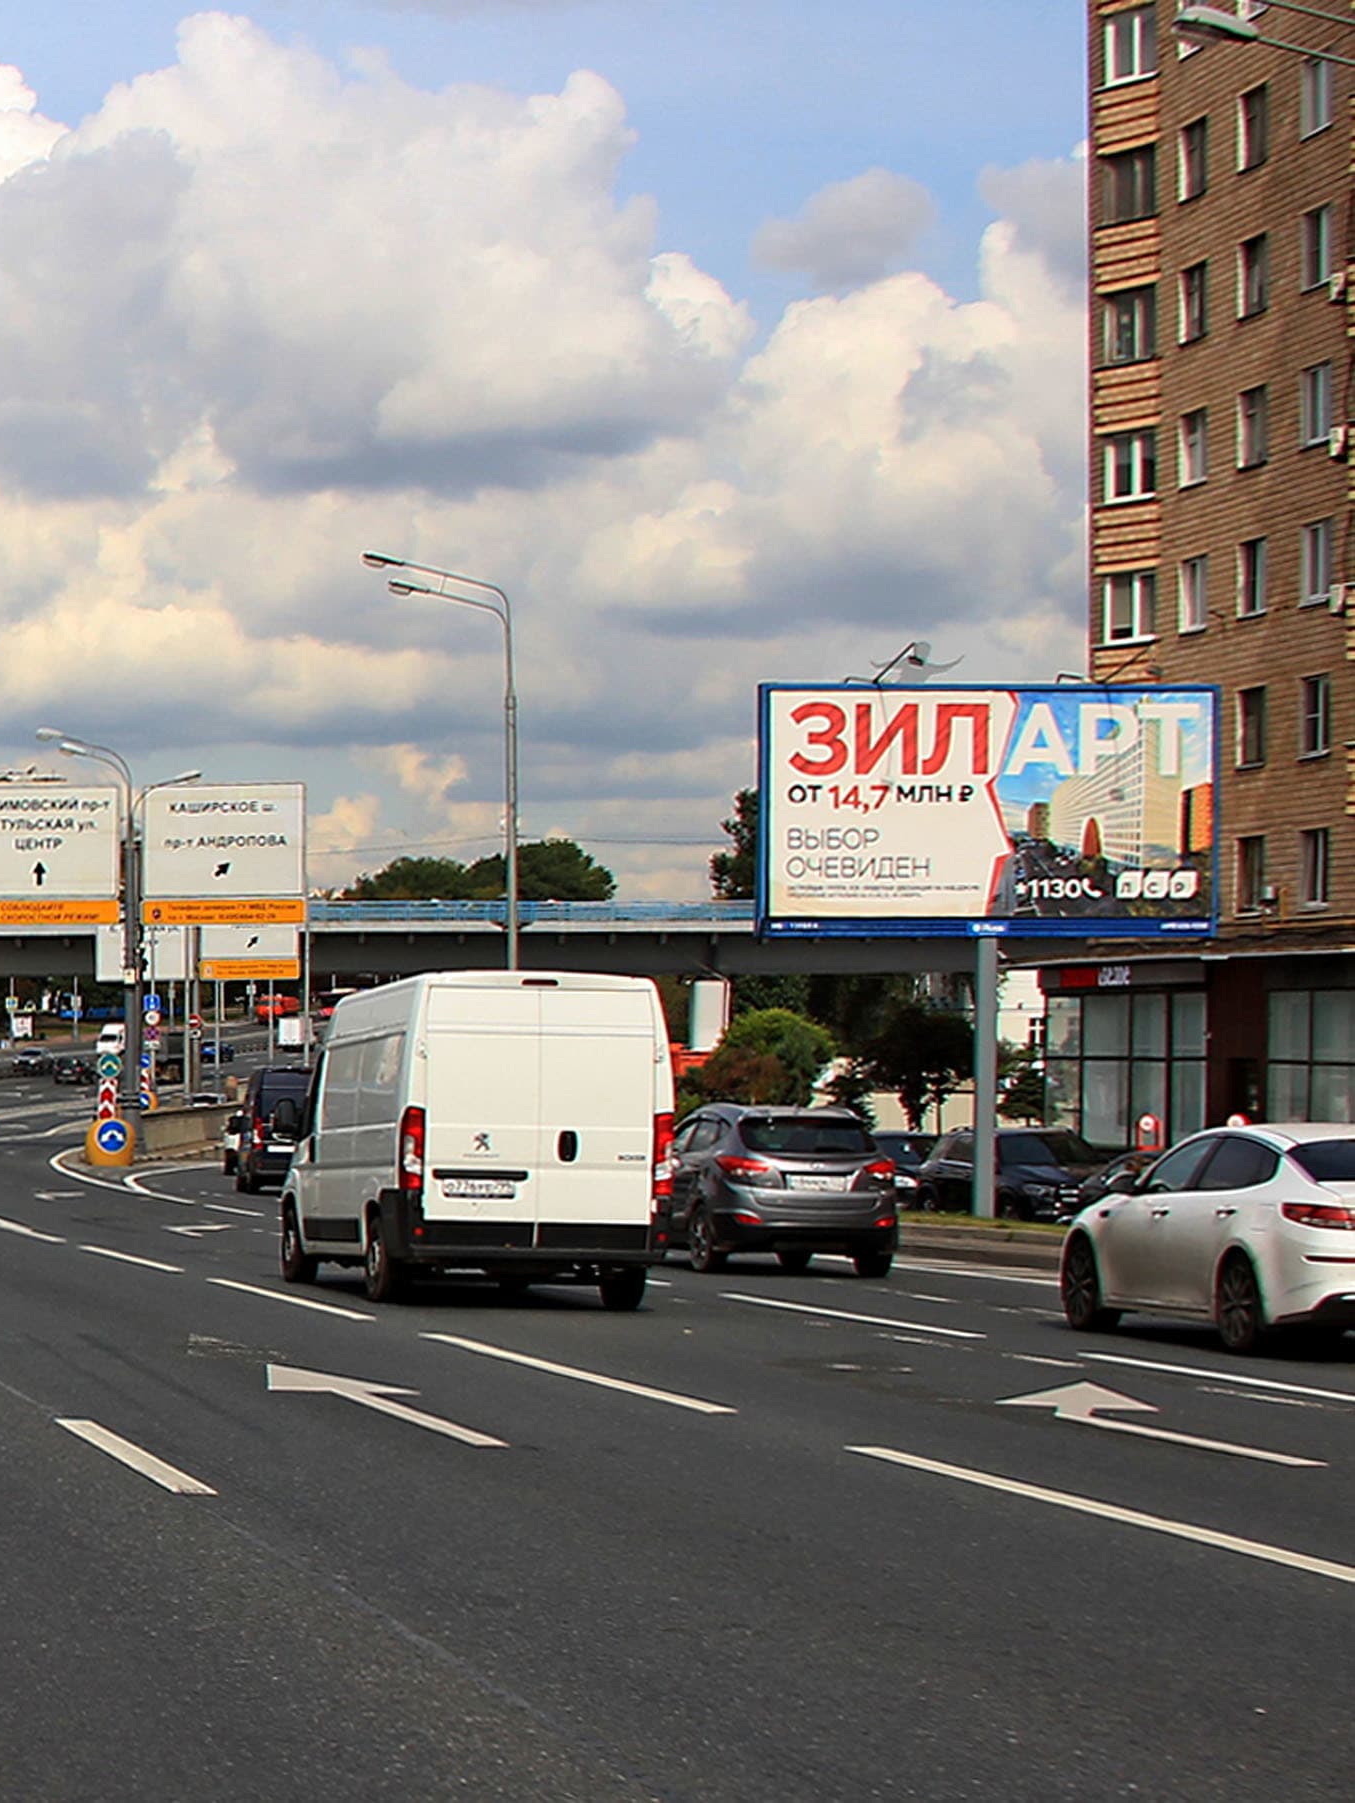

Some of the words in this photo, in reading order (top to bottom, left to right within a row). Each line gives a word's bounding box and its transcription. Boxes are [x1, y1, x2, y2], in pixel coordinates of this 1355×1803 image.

[81, 800, 110, 812] пр-т
[788, 784, 823, 803] ОТ
[828, 785, 890, 814] 14,7
[896, 785, 953, 803] МЛН
[169, 801, 260, 814] КАШИРСКОЕ
[0, 818, 75, 831] ТУЛЬСКАЯ
[14, 837, 63, 851] ЦЕНТР
[164, 838, 193, 850] пр-т
[196, 835, 288, 849] АНДРОПОВА
[787, 828, 880, 850] ВЫБОР
[786, 856, 931, 880] ОЧЕВИДЕН
